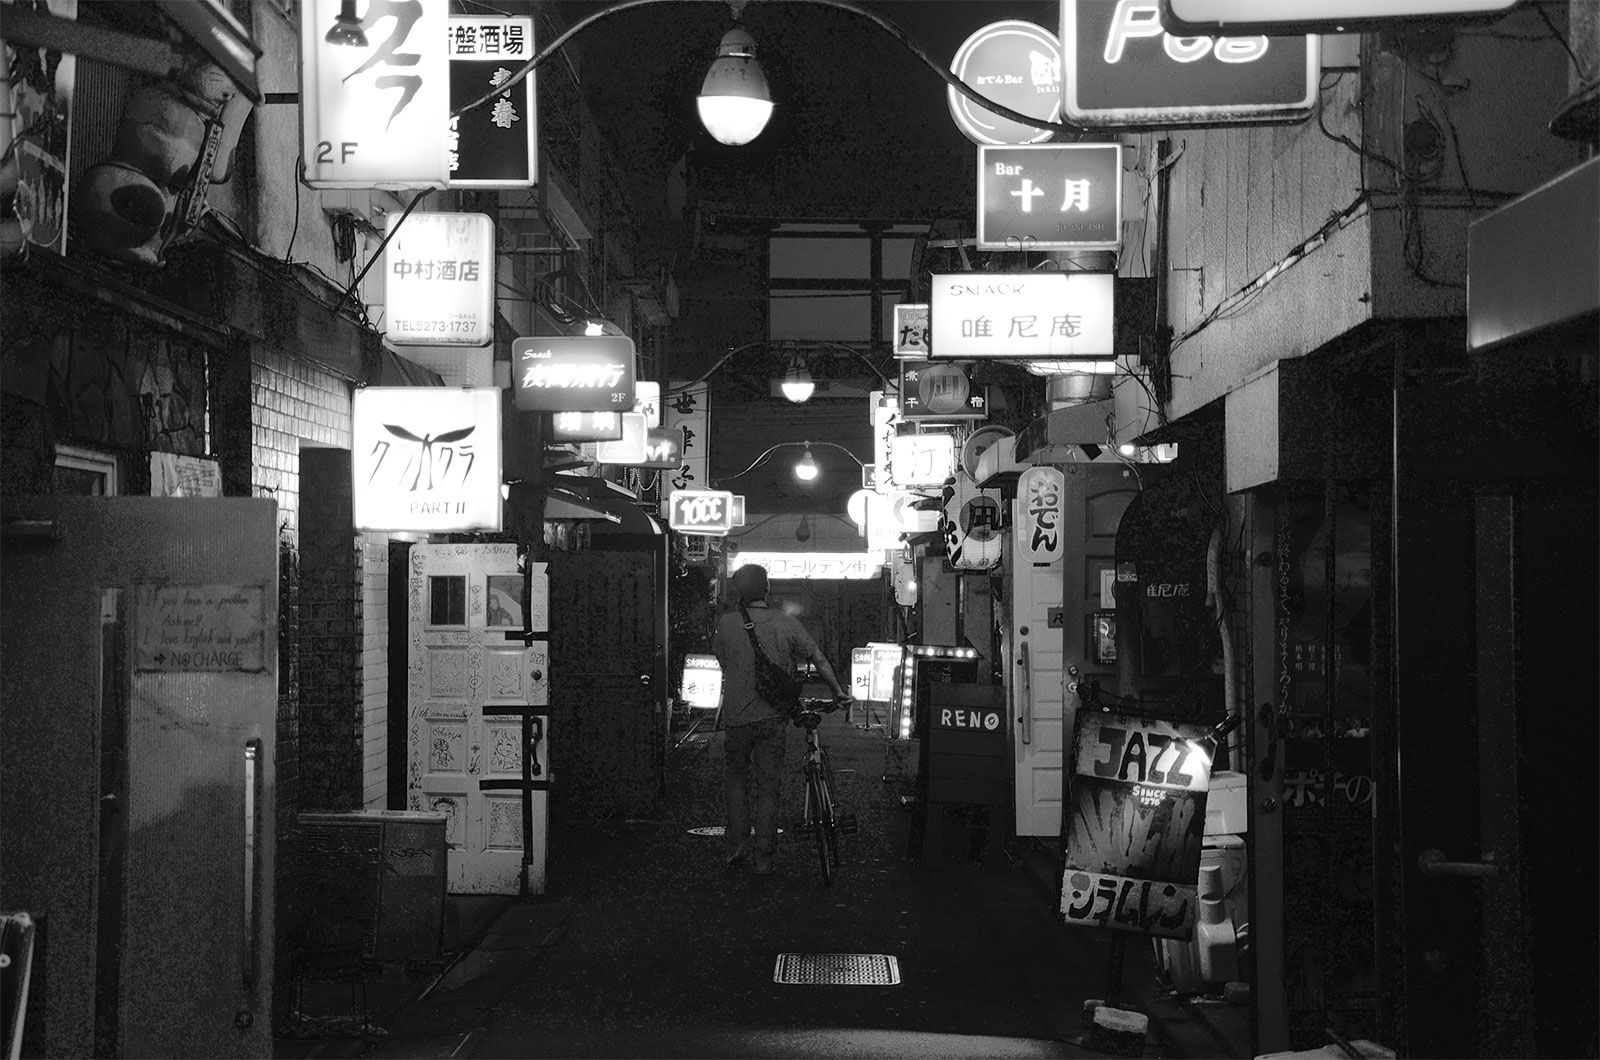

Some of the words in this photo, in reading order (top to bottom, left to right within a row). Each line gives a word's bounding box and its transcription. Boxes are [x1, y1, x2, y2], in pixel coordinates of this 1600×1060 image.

[1004, 74, 1023, 84] Bar
[316, 141, 359, 165] 2F
[995, 162, 1023, 175] Bar
[1010, 178, 1091, 213] 十月
[393, 260, 480, 282] 中村酒店
[950, 284, 1025, 296] SNACK
[962, 314, 1083, 338] 唯尼庵
[900, 325, 929, 348] だ
[522, 349, 553, 360] Snack
[611, 393, 626, 403] 2F
[409, 502, 451, 514] PART
[1029, 482, 1060, 553] おでん
[743, 558, 867, 574] 宿ゴールデン街
[192, 652, 242, 667] CHARGE
[686, 658, 720, 669] SAPPORO
[940, 708, 1000, 731] RENO
[1093, 726, 1194, 787] JAZZ
[1132, 784, 1167, 801] SINCE
